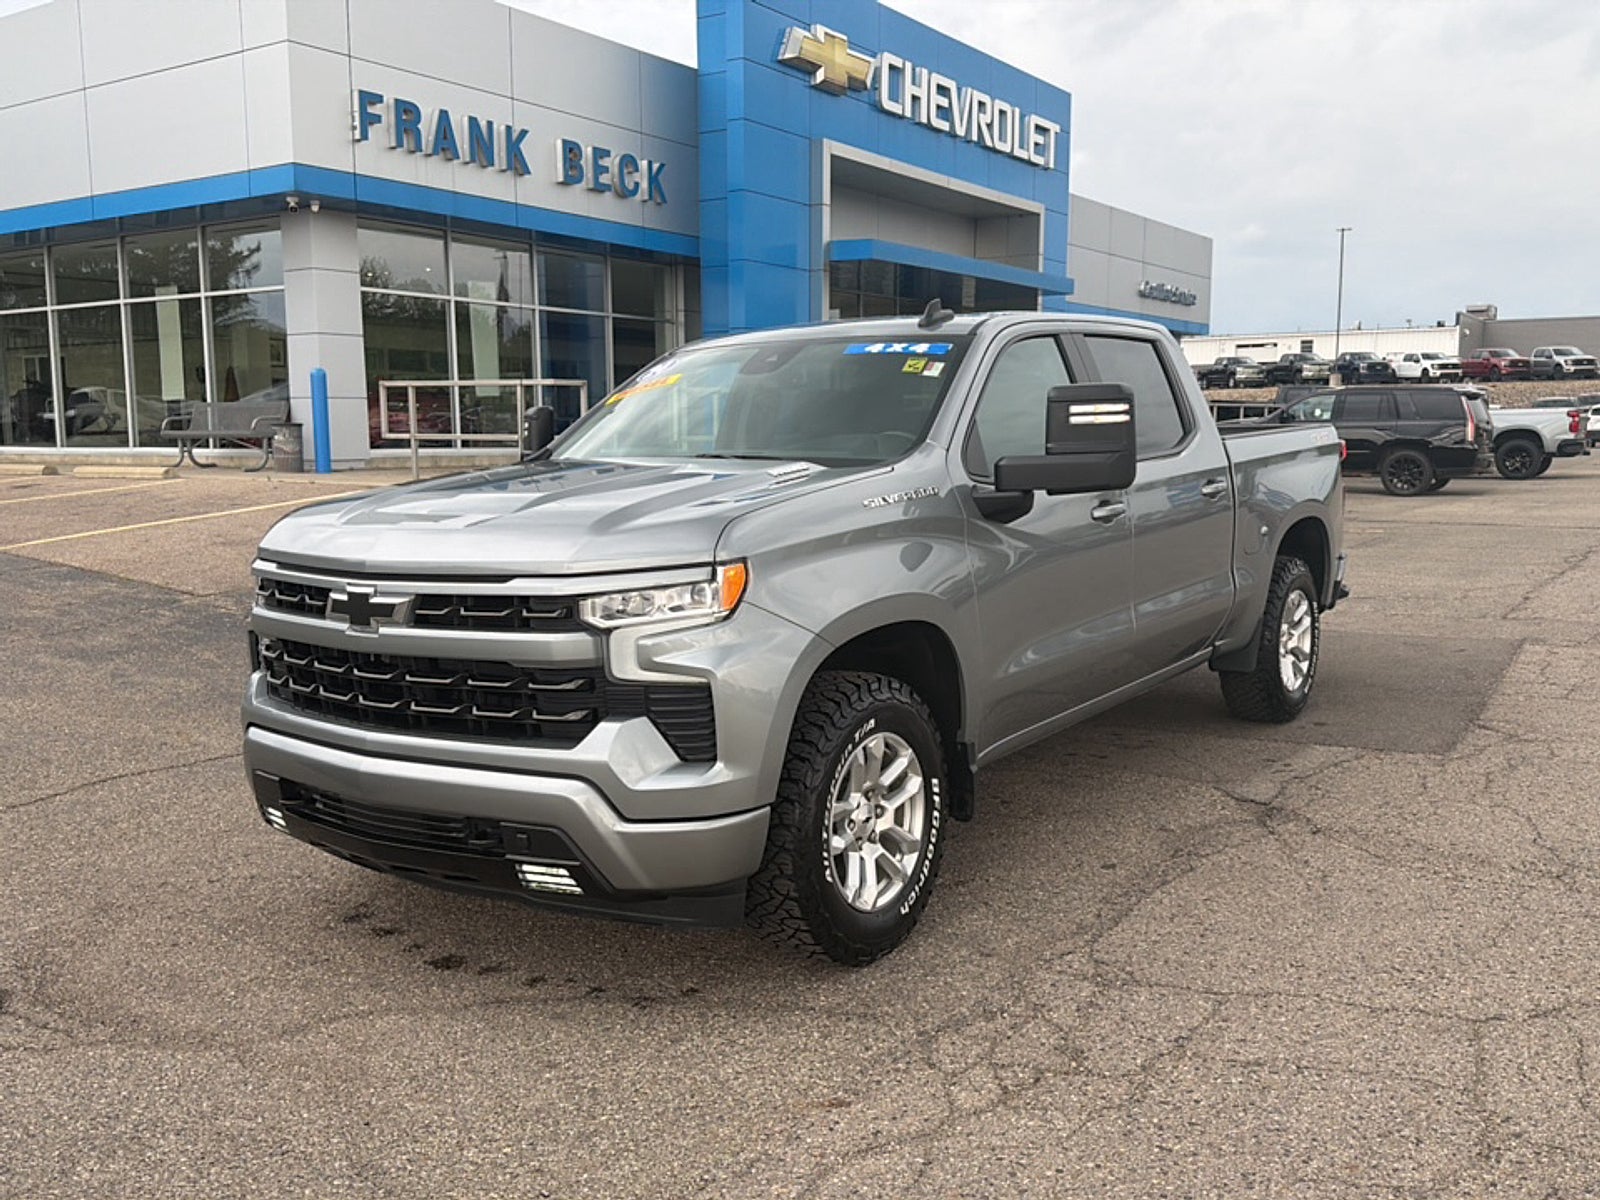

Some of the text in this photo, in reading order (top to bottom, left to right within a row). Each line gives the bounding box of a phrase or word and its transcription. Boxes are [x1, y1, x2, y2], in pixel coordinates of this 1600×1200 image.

[353, 88, 668, 204] FRANK BECK
[878, 51, 1060, 169] CHEVROLET
